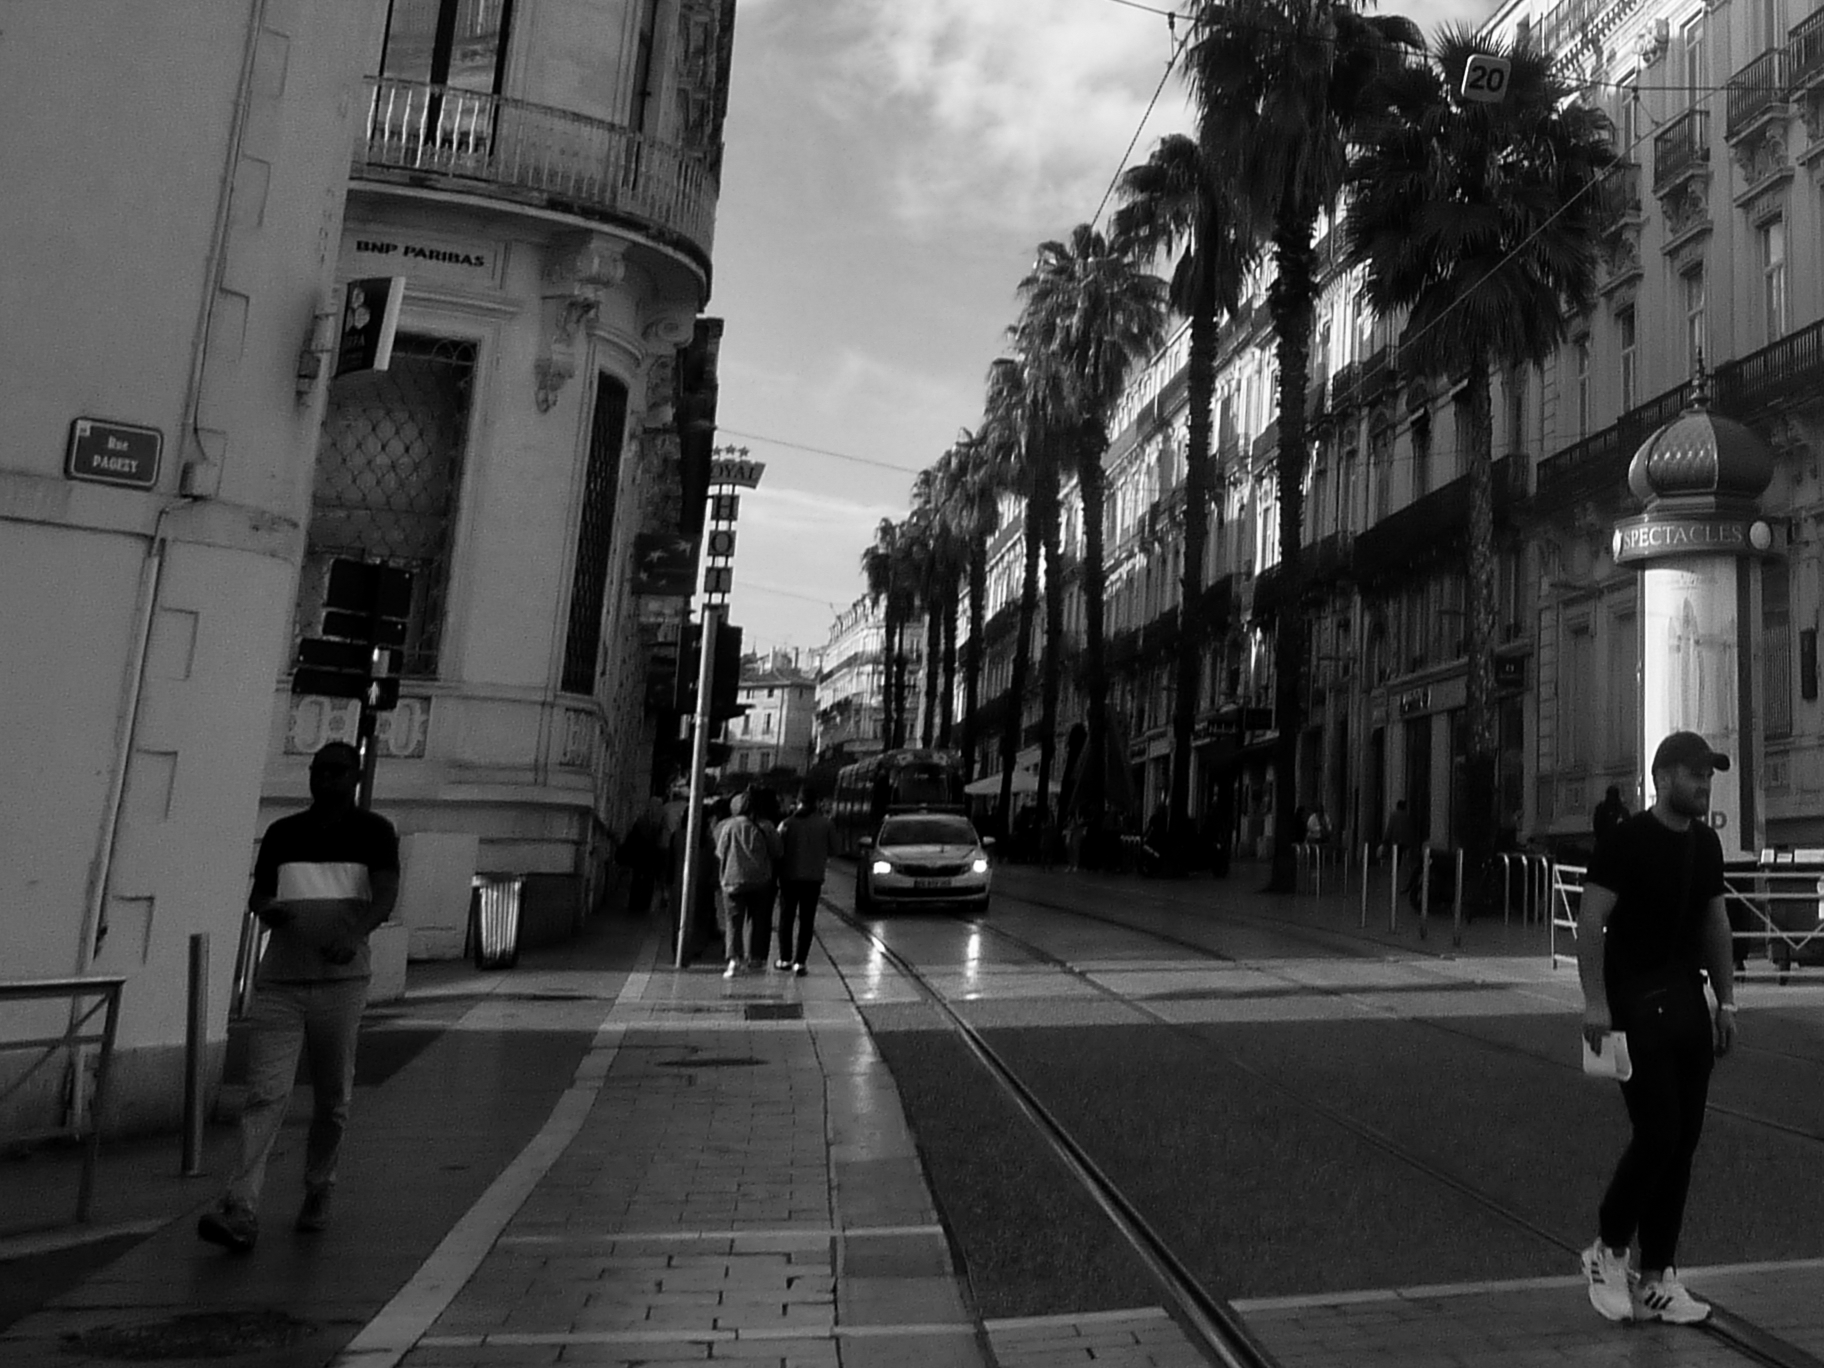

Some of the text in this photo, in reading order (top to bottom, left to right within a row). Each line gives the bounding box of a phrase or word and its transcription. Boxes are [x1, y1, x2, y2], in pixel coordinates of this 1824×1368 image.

[1469, 65, 1504, 92] 20
[356, 240, 485, 267] BNP PARIBAS
[107, 435, 129, 451] Rue
[92, 454, 139, 473] PAGEZY
[710, 463, 759, 480] OYAL
[1622, 524, 1743, 551] SPECTACLES
